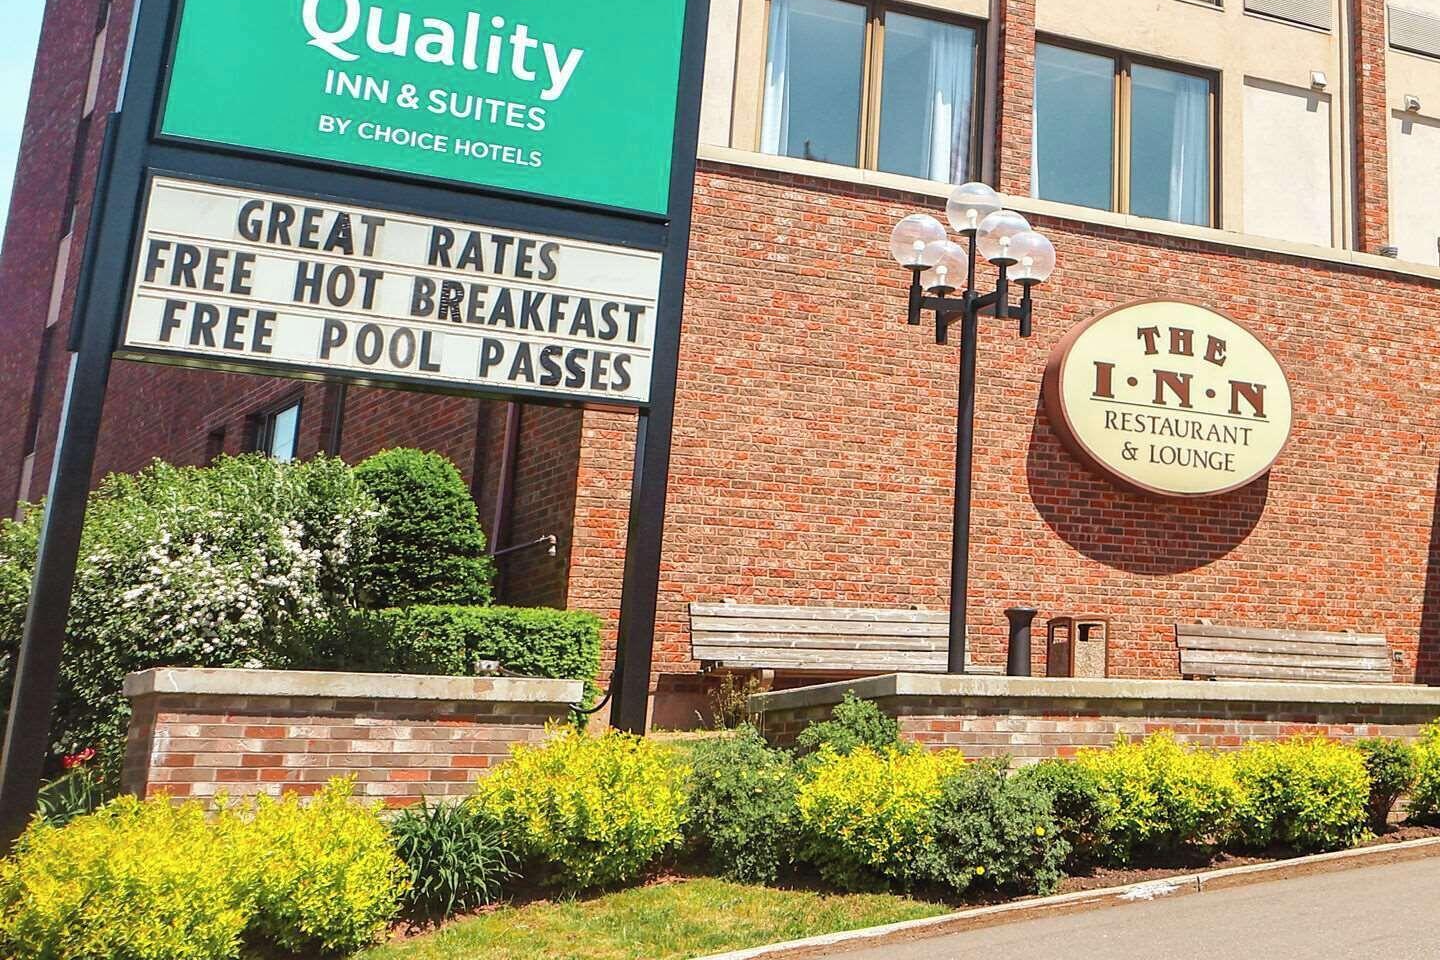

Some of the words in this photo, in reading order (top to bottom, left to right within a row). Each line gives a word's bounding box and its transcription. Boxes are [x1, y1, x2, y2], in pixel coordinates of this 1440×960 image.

[325, 69, 389, 104] INN
[396, 83, 419, 109] &
[428, 89, 546, 131] SUITES
[319, 114, 352, 135] BY
[358, 122, 448, 152] CHOICE
[455, 139, 542, 167] HOTELS
[238, 200, 385, 255] GREAT
[429, 226, 560, 280] RATES
[145, 241, 257, 295] FREE
[294, 261, 383, 309] HOT
[411, 277, 646, 342] BREAKFAST
[160, 299, 277, 353] FREE
[320, 320, 440, 371] POOL
[480, 338, 631, 391] PASSES
[1137, 326, 1227, 367] THE
[1105, 410, 1252, 446] RESTAURANT
[1121, 441, 1138, 461] &
[1149, 444, 1236, 472] LOUNGE
